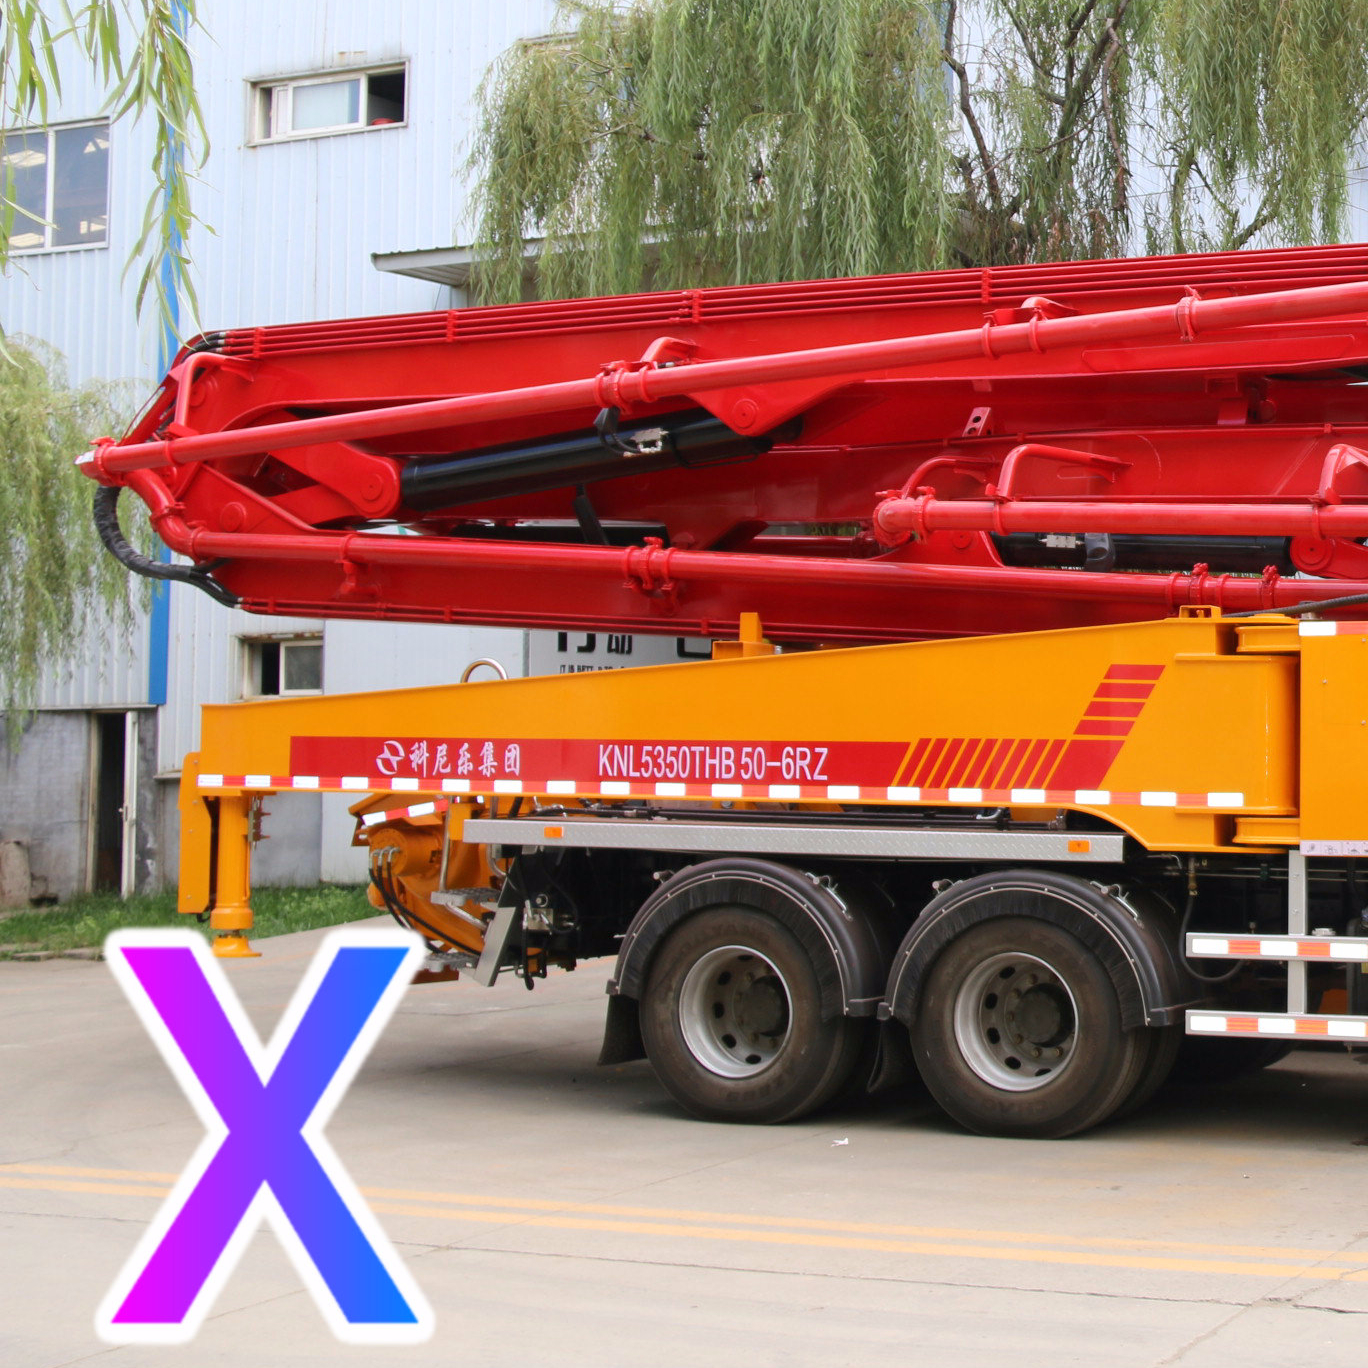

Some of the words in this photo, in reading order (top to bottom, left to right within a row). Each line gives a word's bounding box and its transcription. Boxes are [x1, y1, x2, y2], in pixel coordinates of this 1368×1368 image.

[408, 739, 521, 778] 科尼乐集团
[598, 744, 735, 778] KNL5350THB
